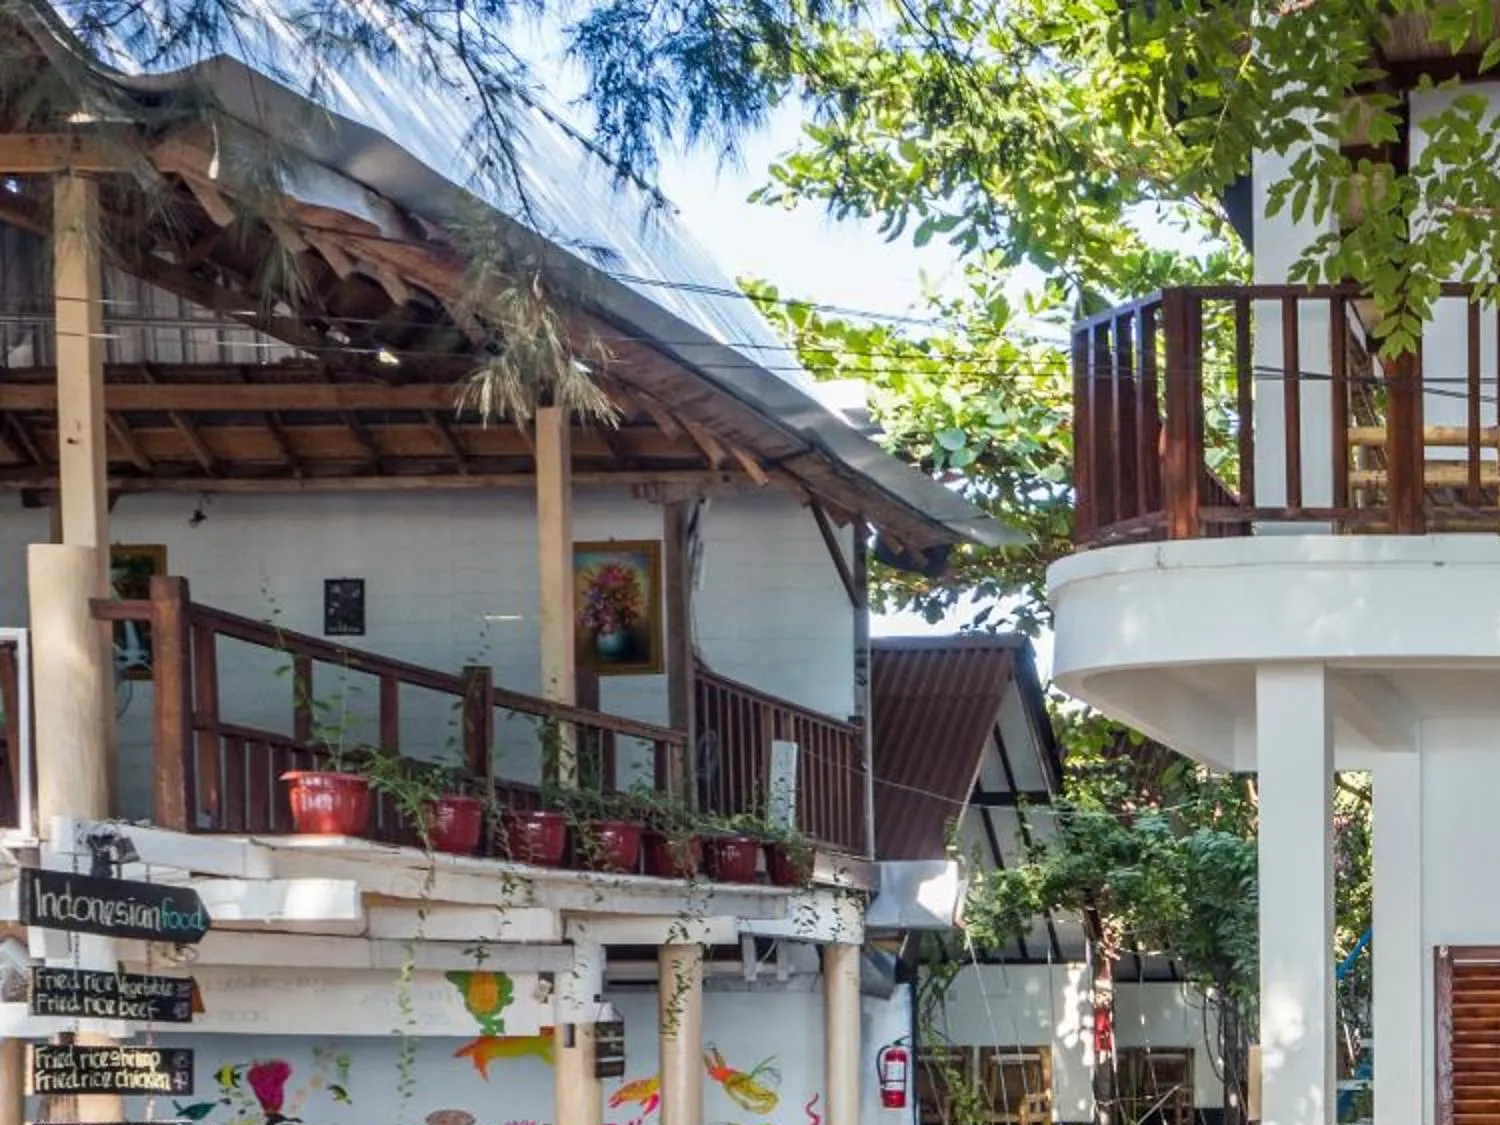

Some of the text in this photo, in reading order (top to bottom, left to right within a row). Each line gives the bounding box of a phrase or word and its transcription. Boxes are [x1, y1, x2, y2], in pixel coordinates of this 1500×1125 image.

[35, 878, 160, 932] Indonesian
[36, 967, 80, 990] Fried
[37, 993, 81, 1014] Fried
[36, 1044, 76, 1070] Fried
[80, 1050, 109, 1069] rice
